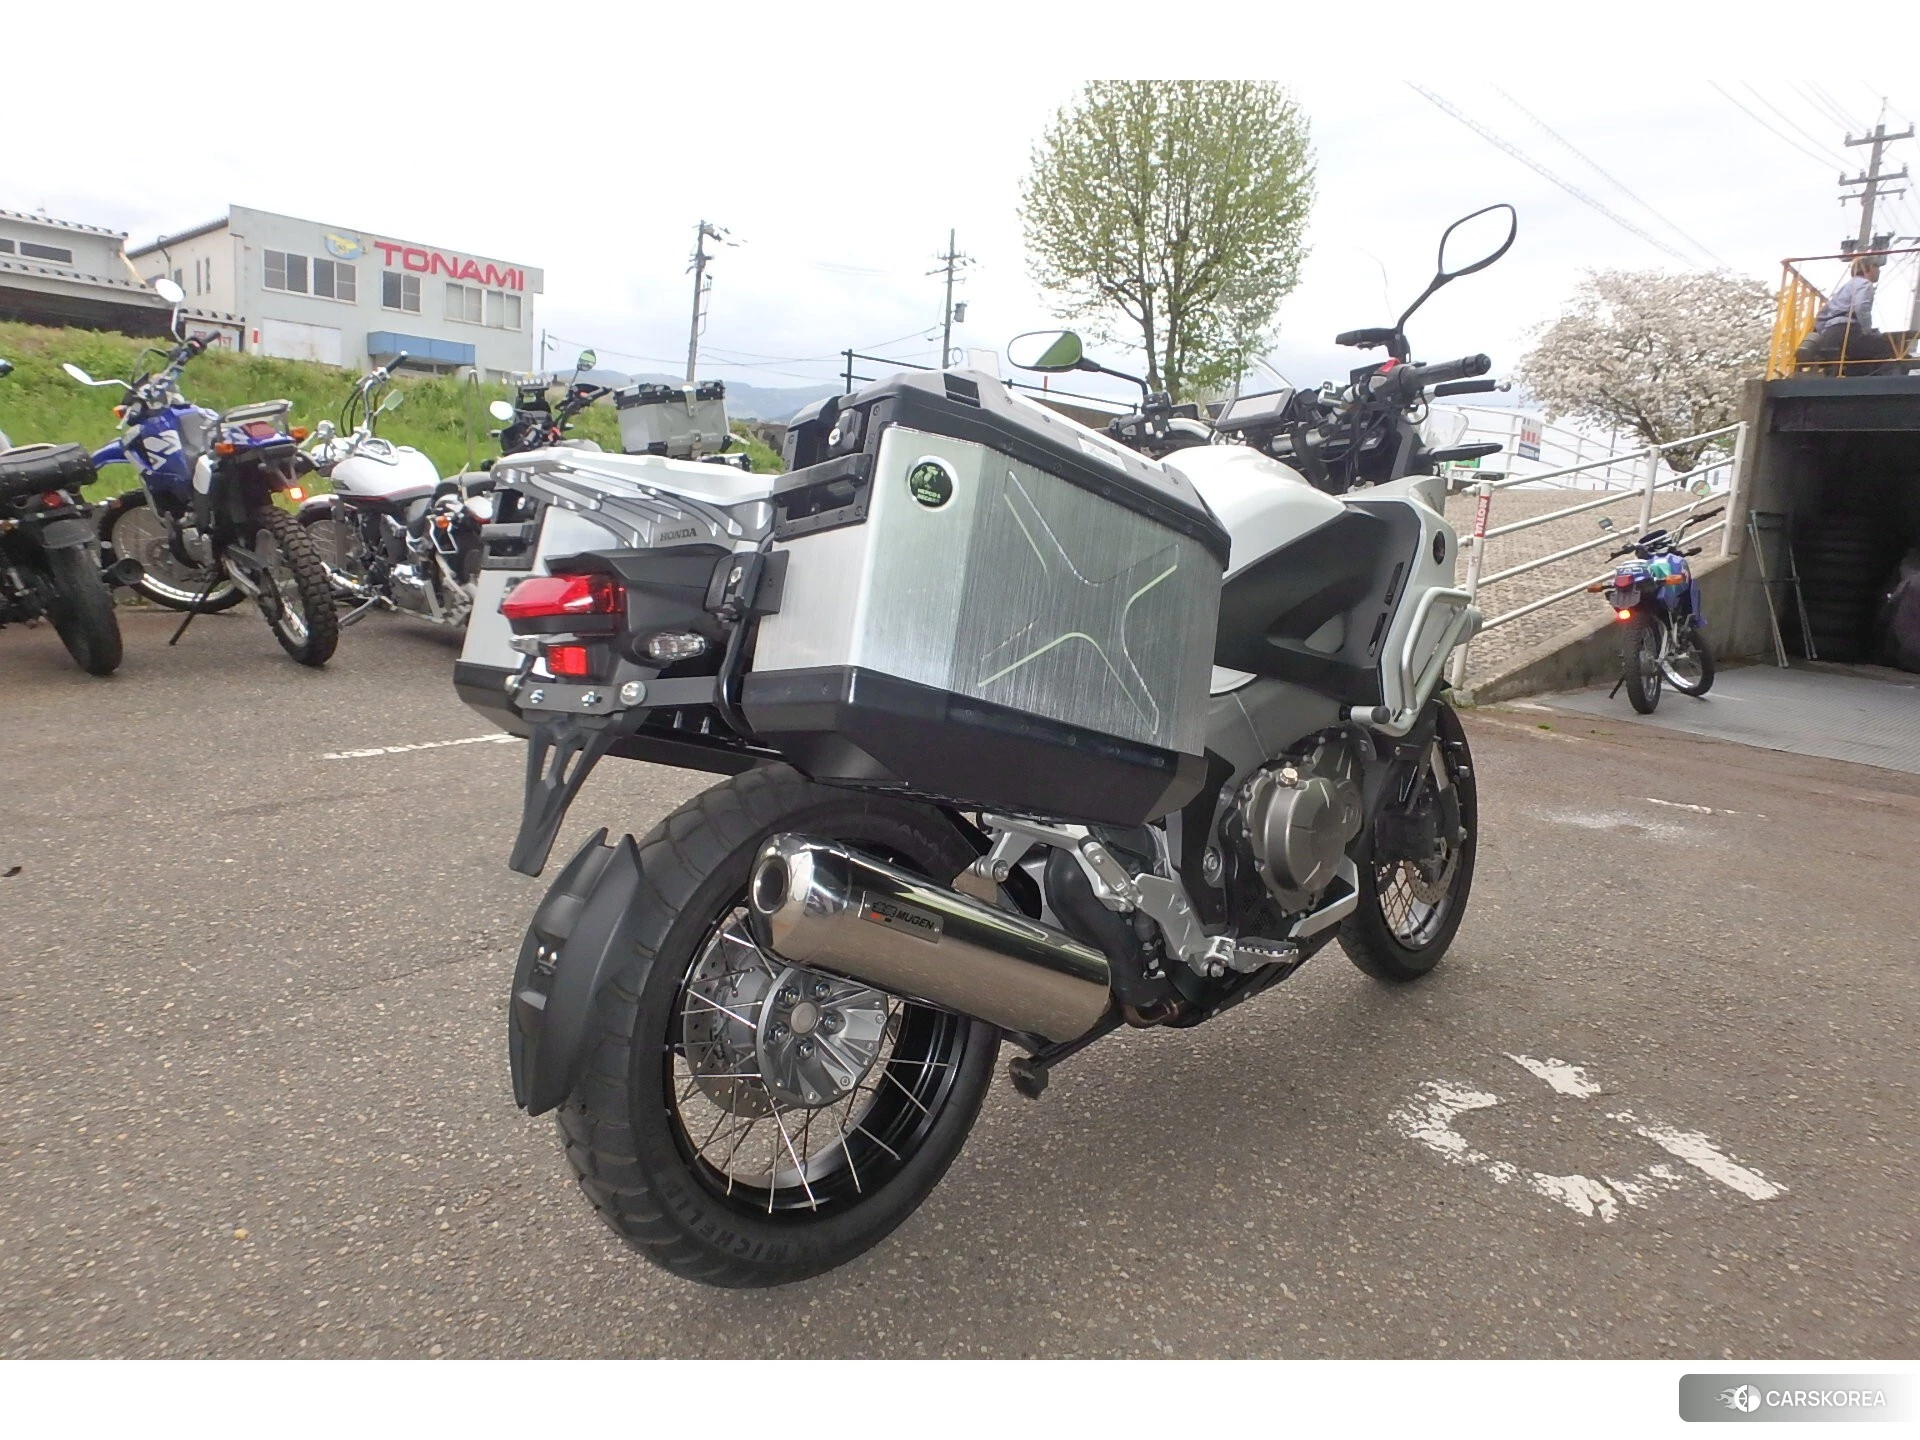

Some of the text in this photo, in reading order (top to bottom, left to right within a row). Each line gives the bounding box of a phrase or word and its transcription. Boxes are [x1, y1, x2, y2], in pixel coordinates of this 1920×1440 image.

[374, 241, 524, 291] TONAMI
[1475, 497, 1488, 535] MOTUL
[660, 528, 697, 541] HONDA
[895, 910, 935, 930] MUGEN
